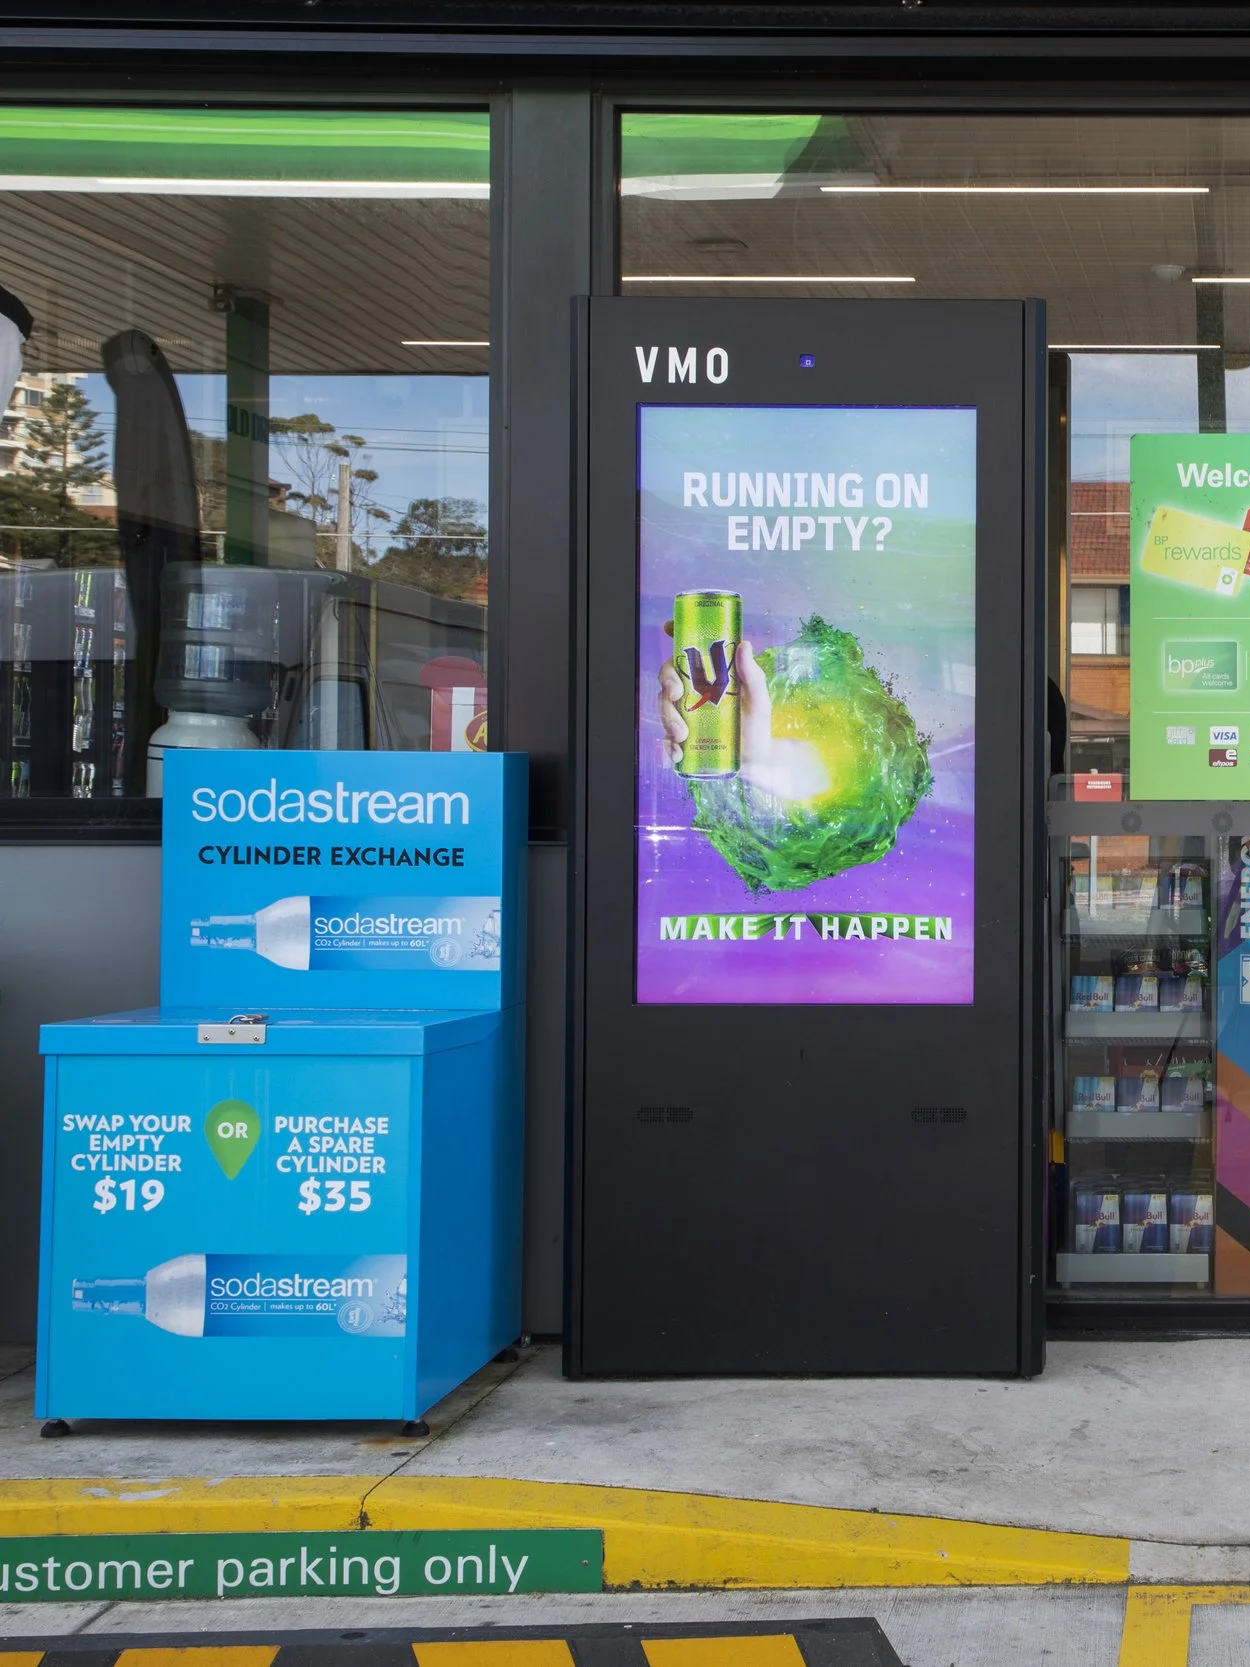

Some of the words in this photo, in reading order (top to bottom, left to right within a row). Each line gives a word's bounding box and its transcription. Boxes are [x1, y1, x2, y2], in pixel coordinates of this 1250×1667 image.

[635, 346, 729, 384] VMO
[683, 472, 864, 508] RUNNING
[875, 473, 929, 508] ON
[727, 516, 893, 551] EMPTY?
[1153, 535, 1169, 546] BP
[1164, 542, 1242, 560] rewards
[694, 600, 725, 608] ORIGINAL
[1168, 655, 1195, 678] bp
[1202, 679, 1233, 687] welcome
[1213, 732, 1237, 740] VISA
[1212, 760, 1234, 768] eftpos
[192, 778, 470, 824] sodastream
[198, 845, 322, 866] CYLINDER
[331, 847, 465, 867] EXCHANGE
[314, 912, 462, 935] sodastream
[659, 916, 759, 940] MAKE
[773, 916, 807, 940] IT
[821, 916, 953, 940] HAPPEN
[315, 939, 332, 947] CO2
[333, 939, 361, 948] Cylinder
[63, 1114, 124, 1132] SWAP
[128, 1115, 191, 1132] YOUR
[217, 1122, 249, 1139] OR
[275, 1116, 389, 1134] PURCHASE
[89, 1134, 164, 1152] EMPTY
[287, 1137, 302, 1153] A
[308, 1136, 375, 1153] SPARE
[71, 1154, 182, 1172] CYLINDER
[276, 1156, 386, 1174] CYLINDER
[92, 1175, 165, 1214] $19
[298, 1176, 372, 1215] $35
[210, 1272, 373, 1297] sodastream
[210, 1302, 229, 1310] CO2
[231, 1302, 261, 1311] Cylinder
[270, 1302, 293, 1310] makes
[295, 1303, 304, 1311] up
[216, 1546, 402, 1596] parking
[424, 1544, 529, 1593] only
